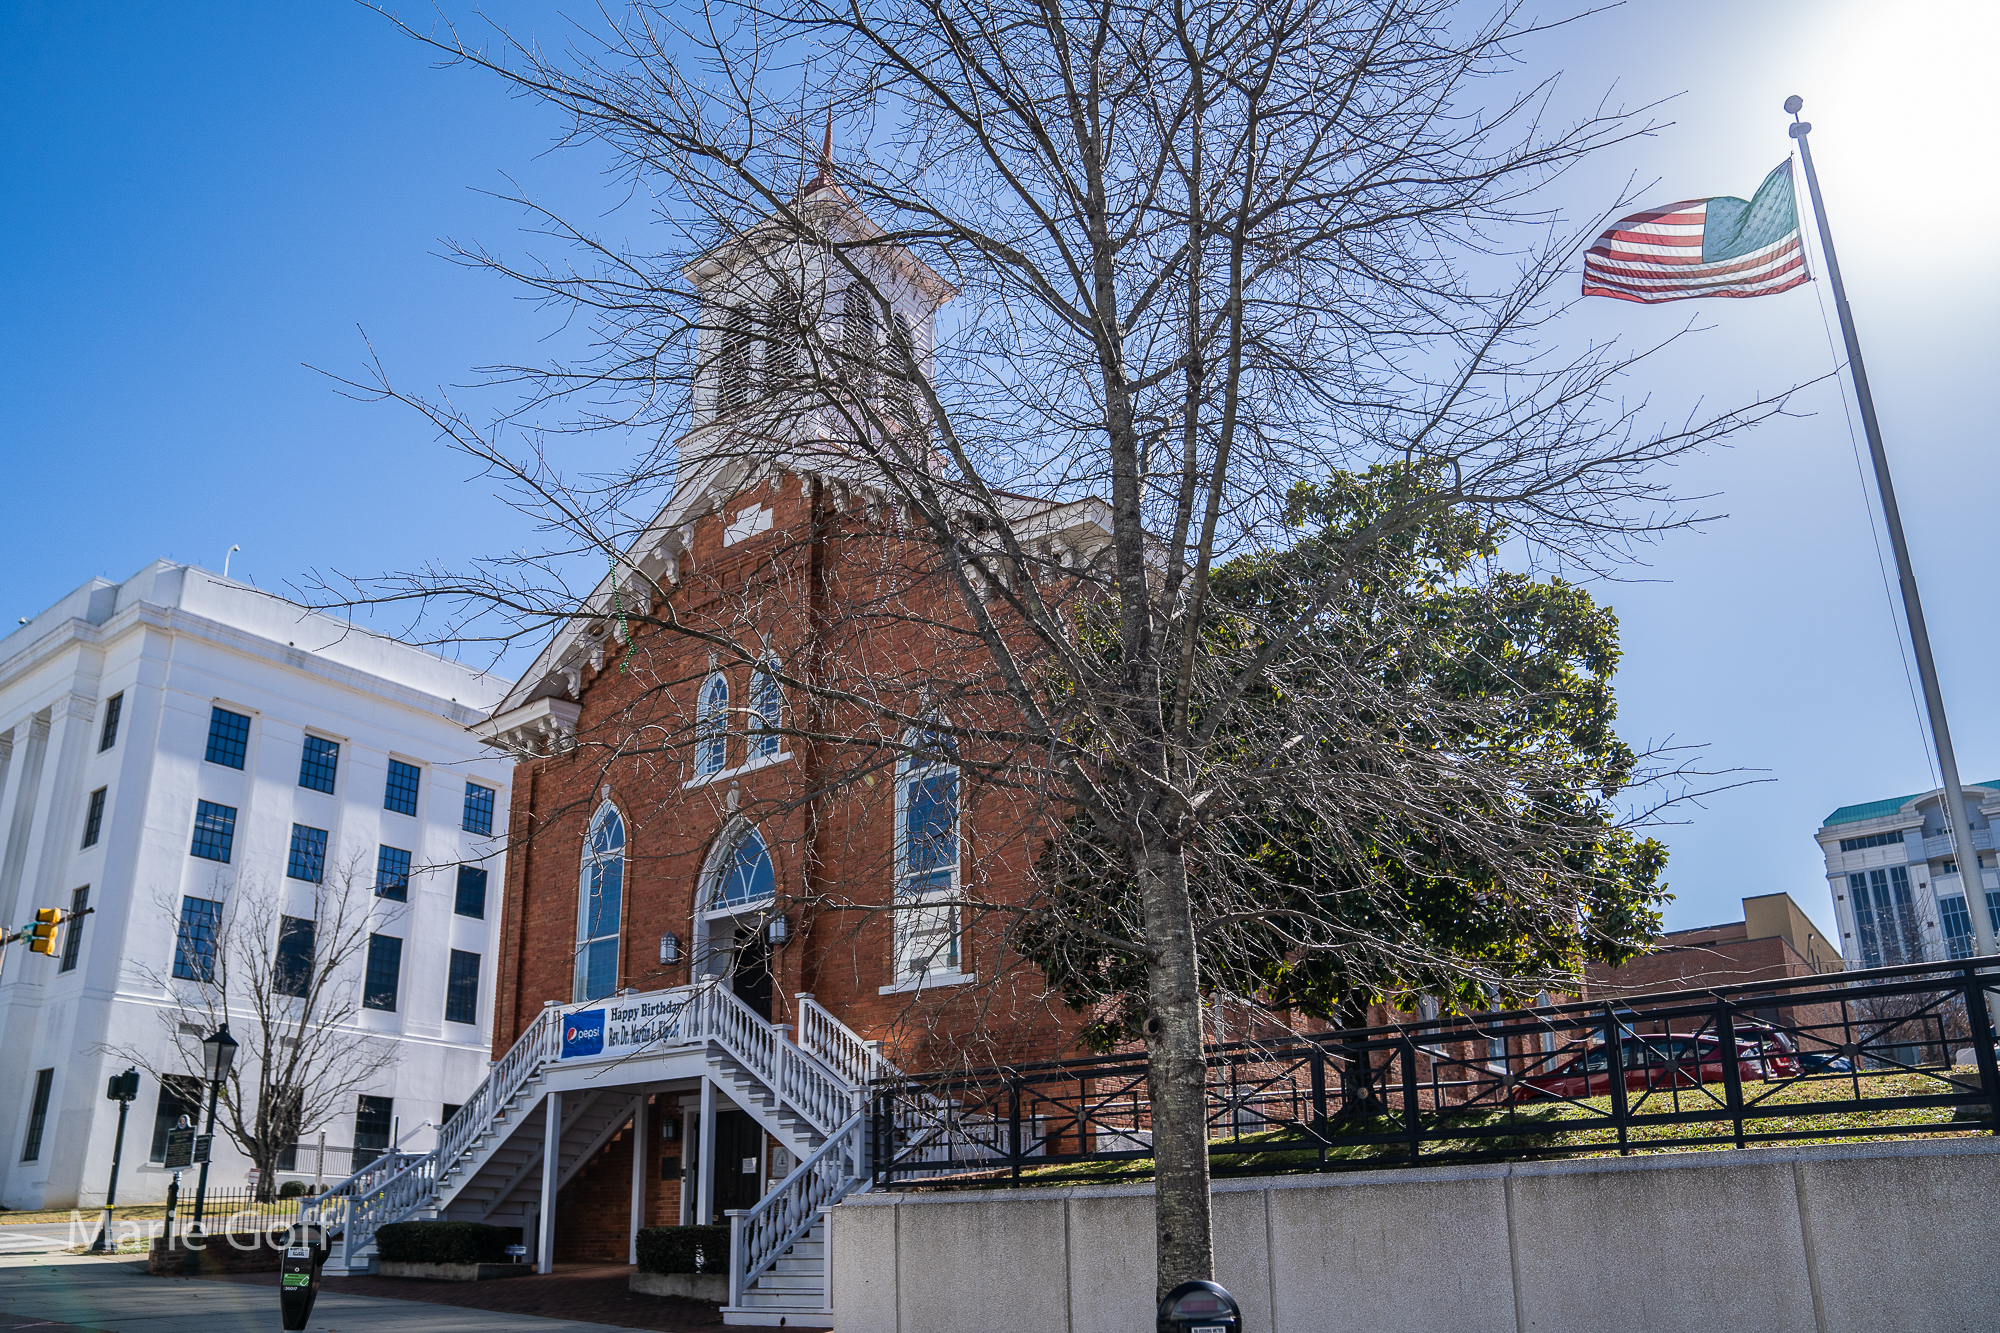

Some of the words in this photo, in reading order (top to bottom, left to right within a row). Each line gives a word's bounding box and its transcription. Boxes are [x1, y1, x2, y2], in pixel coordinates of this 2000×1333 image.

[610, 1007, 640, 1023] Happy
[641, 1000, 684, 1017] Birthday
[578, 1026, 600, 1043] pepsi
[608, 1027, 620, 1047] Rev.
